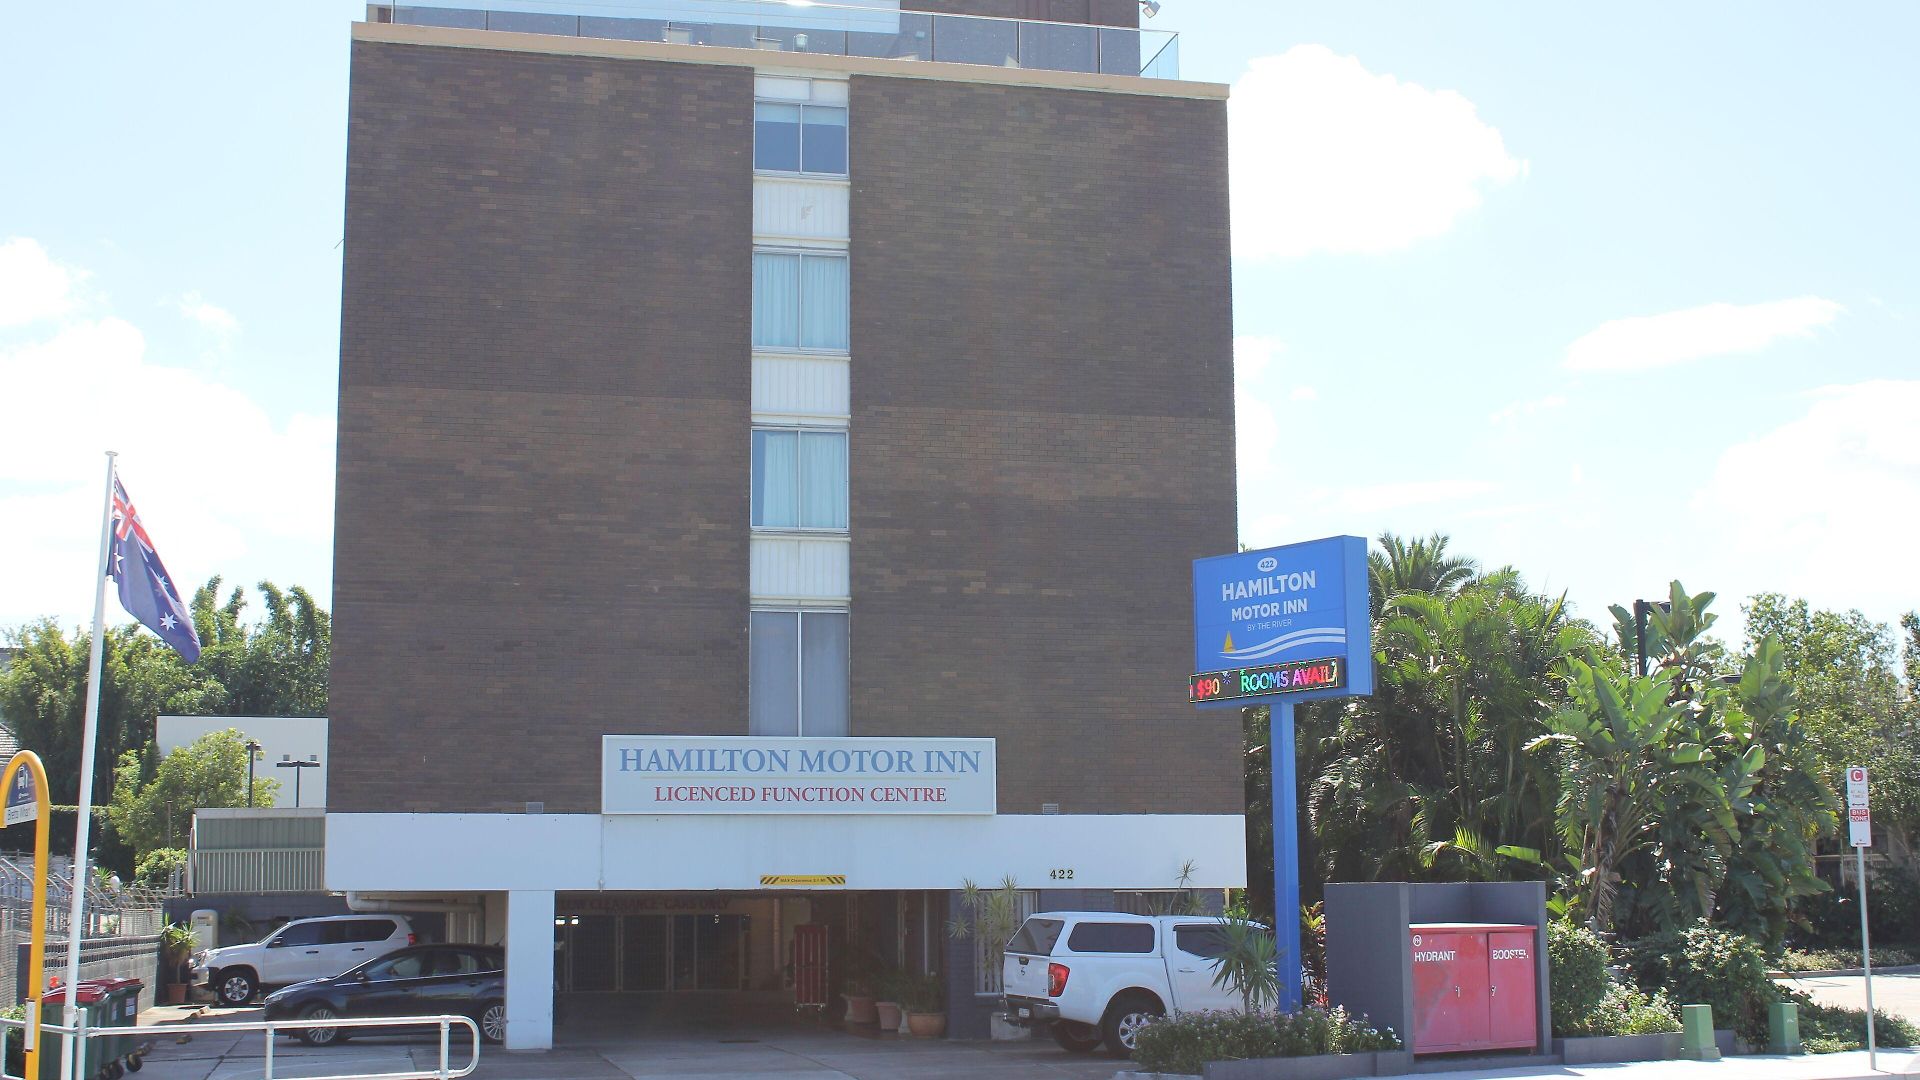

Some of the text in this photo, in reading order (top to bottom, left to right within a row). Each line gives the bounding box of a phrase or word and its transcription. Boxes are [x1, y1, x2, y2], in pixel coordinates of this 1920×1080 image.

[1260, 560, 1275, 569] 422
[1222, 570, 1316, 601] HAMILTON
[1231, 598, 1308, 621] MOTOR INN
[1247, 619, 1292, 632] BY THE RIVER
[1197, 678, 1220, 698] $90
[1241, 670, 1289, 692] ROOMS
[619, 748, 981, 774] HAMILTON MOTOR INN
[655, 786, 947, 802] LICENCED FUNCTION CENTRE
[1050, 870, 1074, 880] 422
[1414, 951, 1456, 962] HYDRANT
